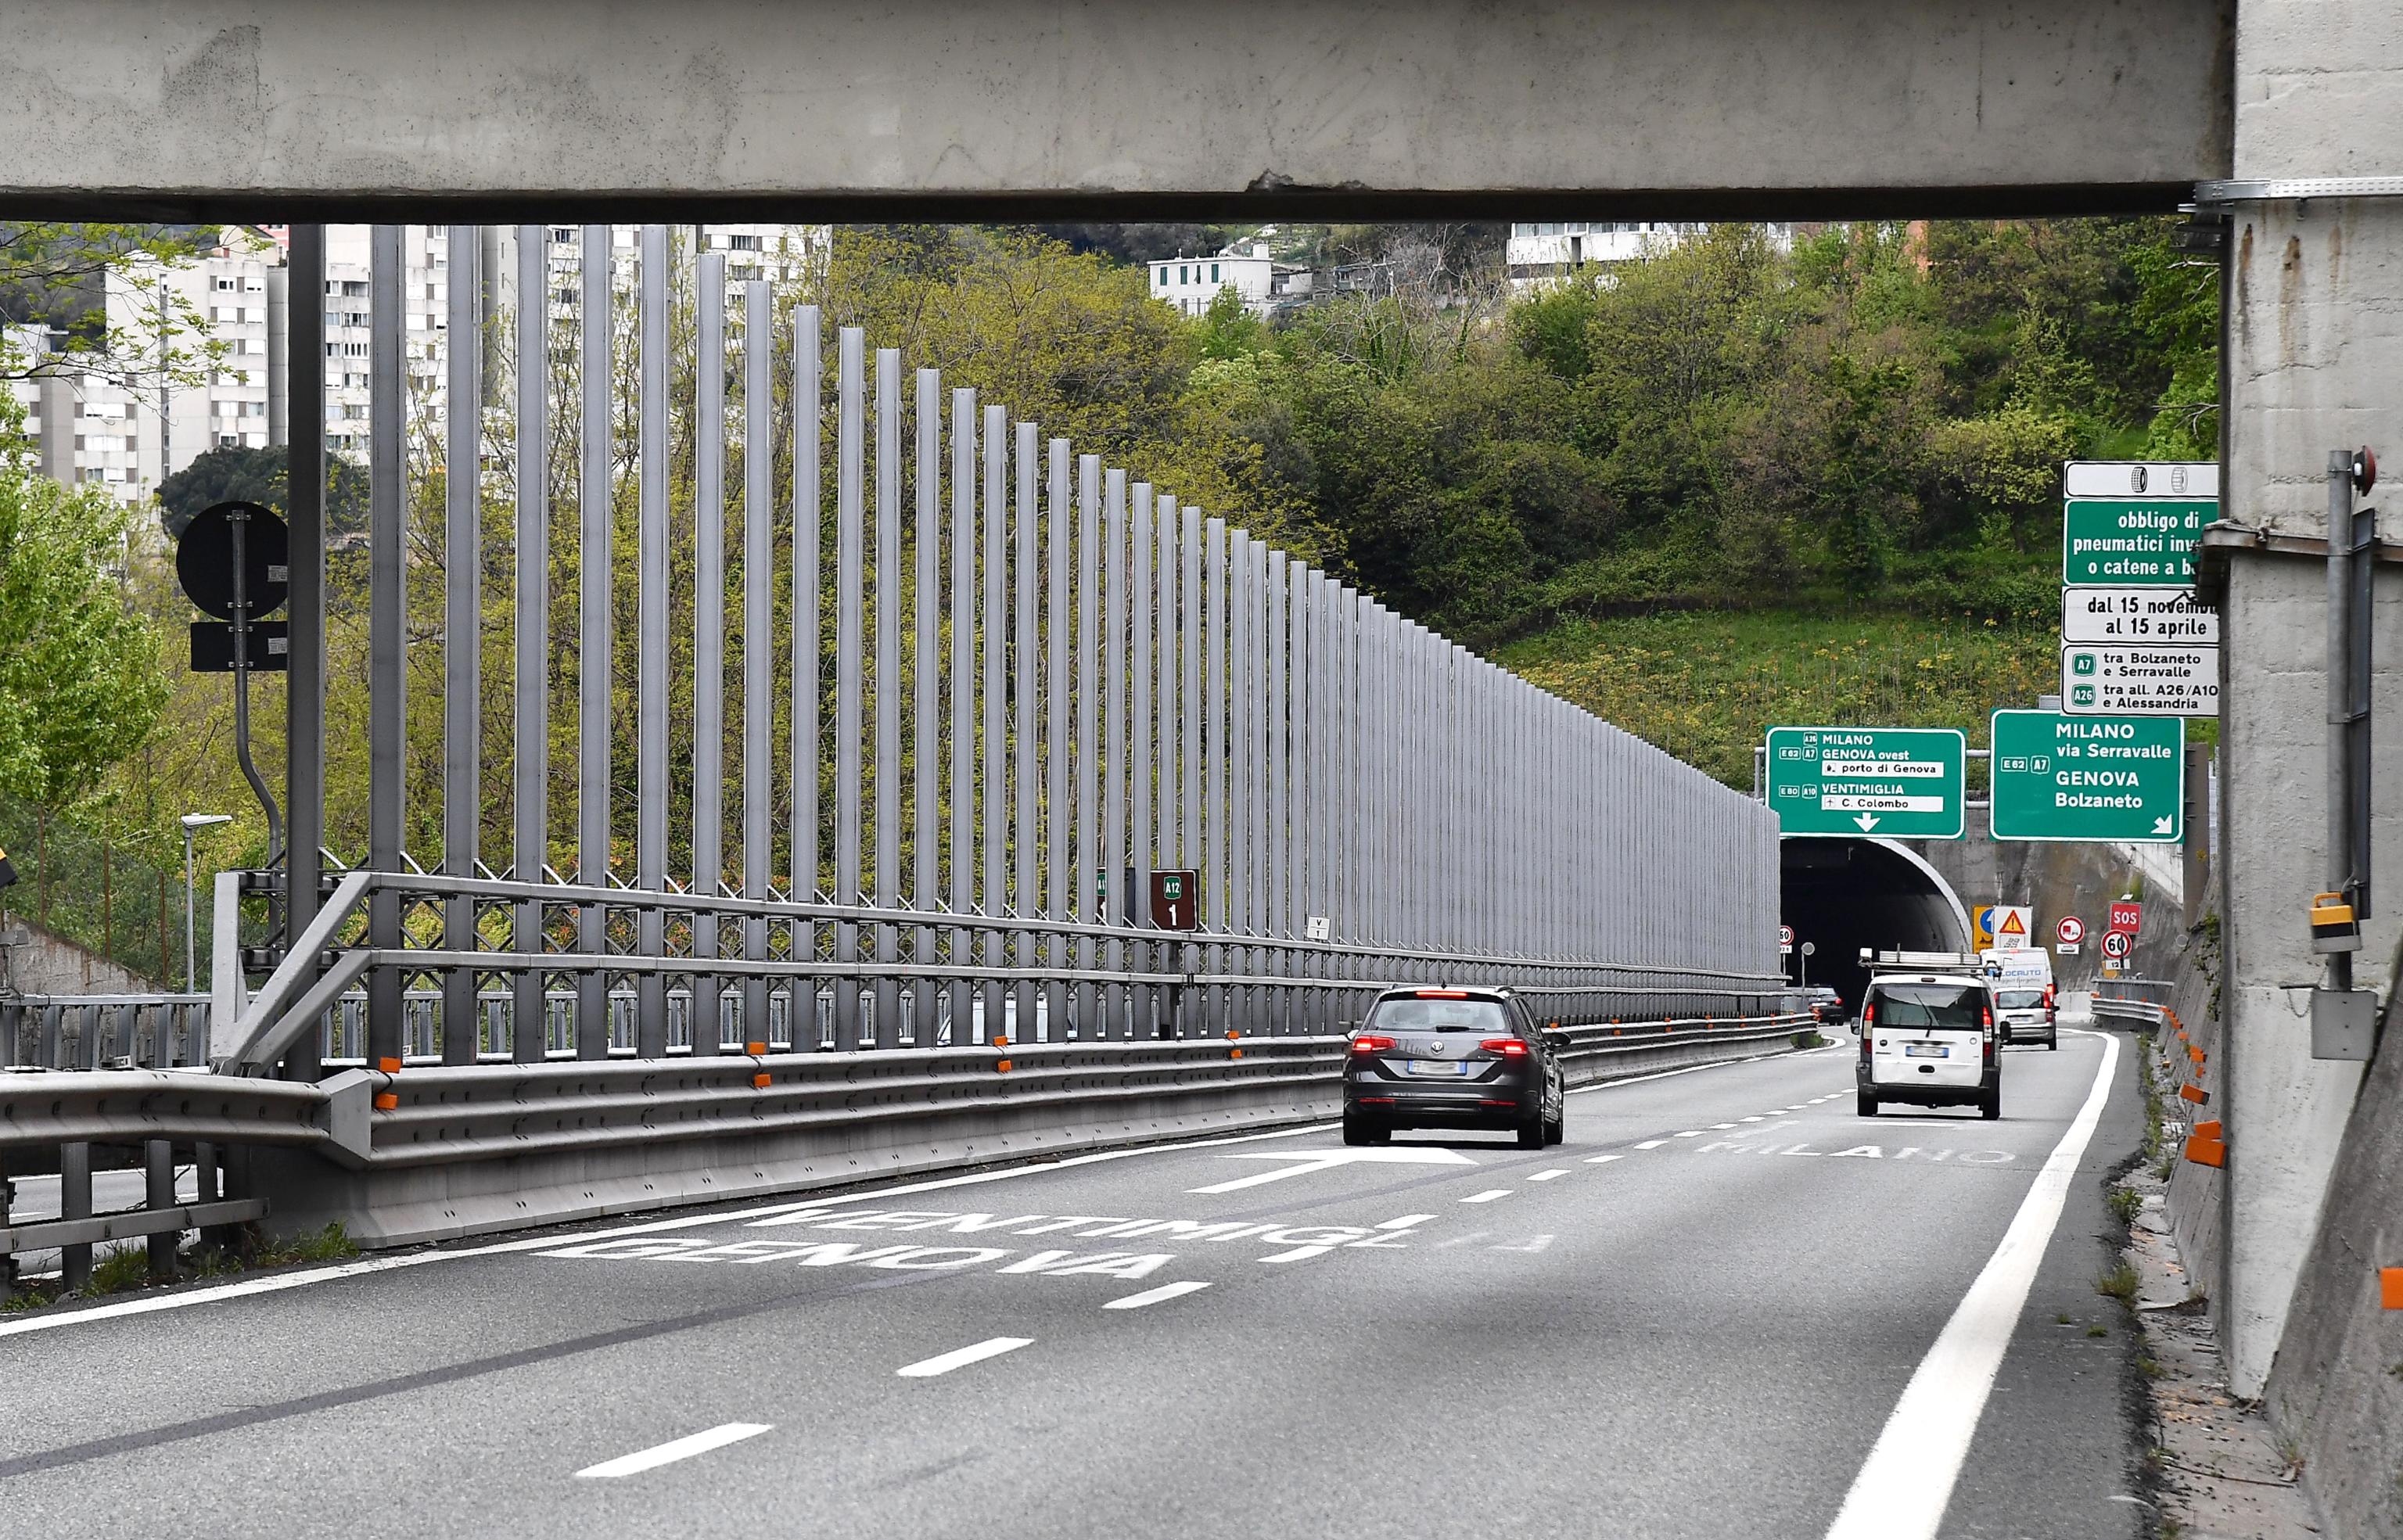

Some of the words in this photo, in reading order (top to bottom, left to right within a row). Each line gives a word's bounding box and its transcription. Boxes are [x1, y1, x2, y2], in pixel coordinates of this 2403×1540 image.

[2118, 511, 2178, 532] obbligo
[2184, 511, 2199, 529] di
[2074, 535, 2163, 555] pneumatici
[2170, 535, 2201, 552] inv
[2088, 562, 2097, 574] o
[2103, 559, 2158, 575] catene
[2164, 562, 2175, 575] a
[2088, 597, 2113, 613] dal
[2121, 597, 2139, 613] 15
[2106, 619, 2122, 634] al
[2131, 619, 2150, 634] 15
[2157, 618, 2207, 639] aprile
[2078, 659, 2091, 670] A7
[2103, 654, 2124, 663] tra
[2130, 653, 2201, 665] Bolzaneto
[2103, 667, 2112, 677] e
[2119, 666, 2191, 677] Serravalle
[2074, 690, 2092, 701] A26
[2103, 685, 2124, 695] tra
[2128, 685, 2150, 695] all.
[2103, 699, 2111, 708] e
[2117, 698, 2199, 709] Alessandria
[2056, 723, 2135, 739] MILANO
[1823, 734, 1873, 745] MILANO
[1805, 749, 1816, 758] A7
[1822, 749, 1876, 759] GENOVA
[1878, 750, 1909, 760] ovest
[2056, 745, 2081, 757] via
[2086, 744, 2171, 759] Serravalle
[1842, 764, 1873, 774] porto
[1877, 764, 1888, 773] di
[1893, 764, 1937, 774] Genova
[2034, 759, 2047, 770] A7
[2056, 771, 2139, 787] GENOVA
[1822, 783, 1904, 795] VENTIMIGLIA
[1841, 798, 1854, 807] C.
[1858, 799, 1909, 809] Colombo
[2055, 793, 2143, 809] Bolzaneto
[1166, 882, 1180, 893] A12
[1169, 904, 1177, 926] 1
[2114, 911, 2137, 924] SOS
[2108, 938, 2125, 951] 60
[1693, 1141, 2016, 1163] MILANO
[529, 1238, 1177, 1279] GENOVA
